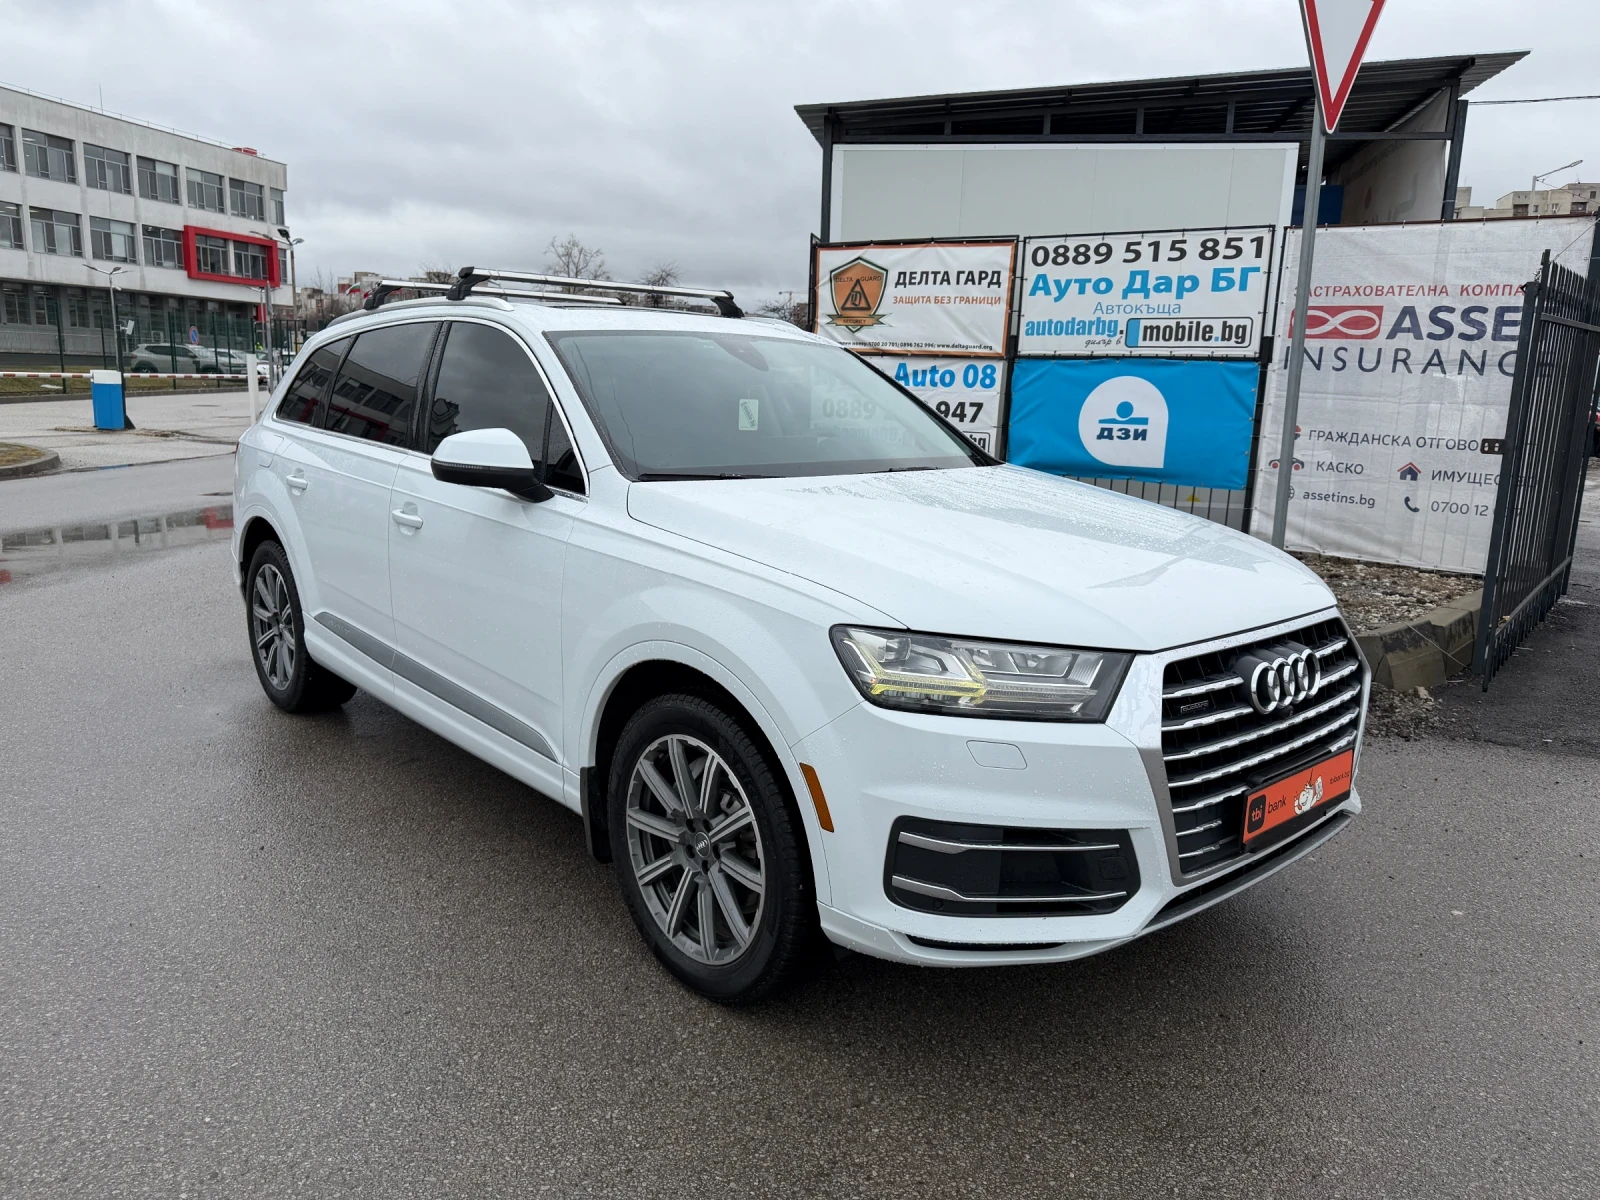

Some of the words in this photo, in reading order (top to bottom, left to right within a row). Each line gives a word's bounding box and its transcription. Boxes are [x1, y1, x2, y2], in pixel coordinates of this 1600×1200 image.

[1031, 242, 1113, 267] 0889
[1122, 239, 1187, 263] 515
[1198, 236, 1264, 260] 851
[894, 271, 951, 288] ДЕЛТА
[956, 270, 1002, 288] ГАРД
[1028, 273, 1114, 303] Ауто
[1122, 270, 1200, 300] Дар
[1211, 266, 1261, 292] БГ
[893, 295, 932, 306] ЗАЩИТА
[933, 296, 951, 304] БЕЗ
[953, 296, 1001, 306] ГРАНИЦИ
[1092, 302, 1181, 316] Автокъща
[1142, 320, 1247, 344] mobile.bg
[1385, 305, 1523, 342] ASSE
[894, 362, 956, 387] Auto
[962, 363, 997, 389] 08
[935, 400, 984, 424] 947
[1096, 427, 1148, 441] ДЗИ
[1308, 429, 1412, 447] ГРАЖДАНСКА
[1415, 436, 1479, 451] ОТГОВО
[1316, 460, 1364, 475] КАСКО
[1303, 490, 1375, 509] assetins.bg
[1431, 500, 1470, 515] 0700
[1474, 504, 1489, 517] 12
[1251, 804, 1263, 822] tbi
[1267, 795, 1287, 814] bank
